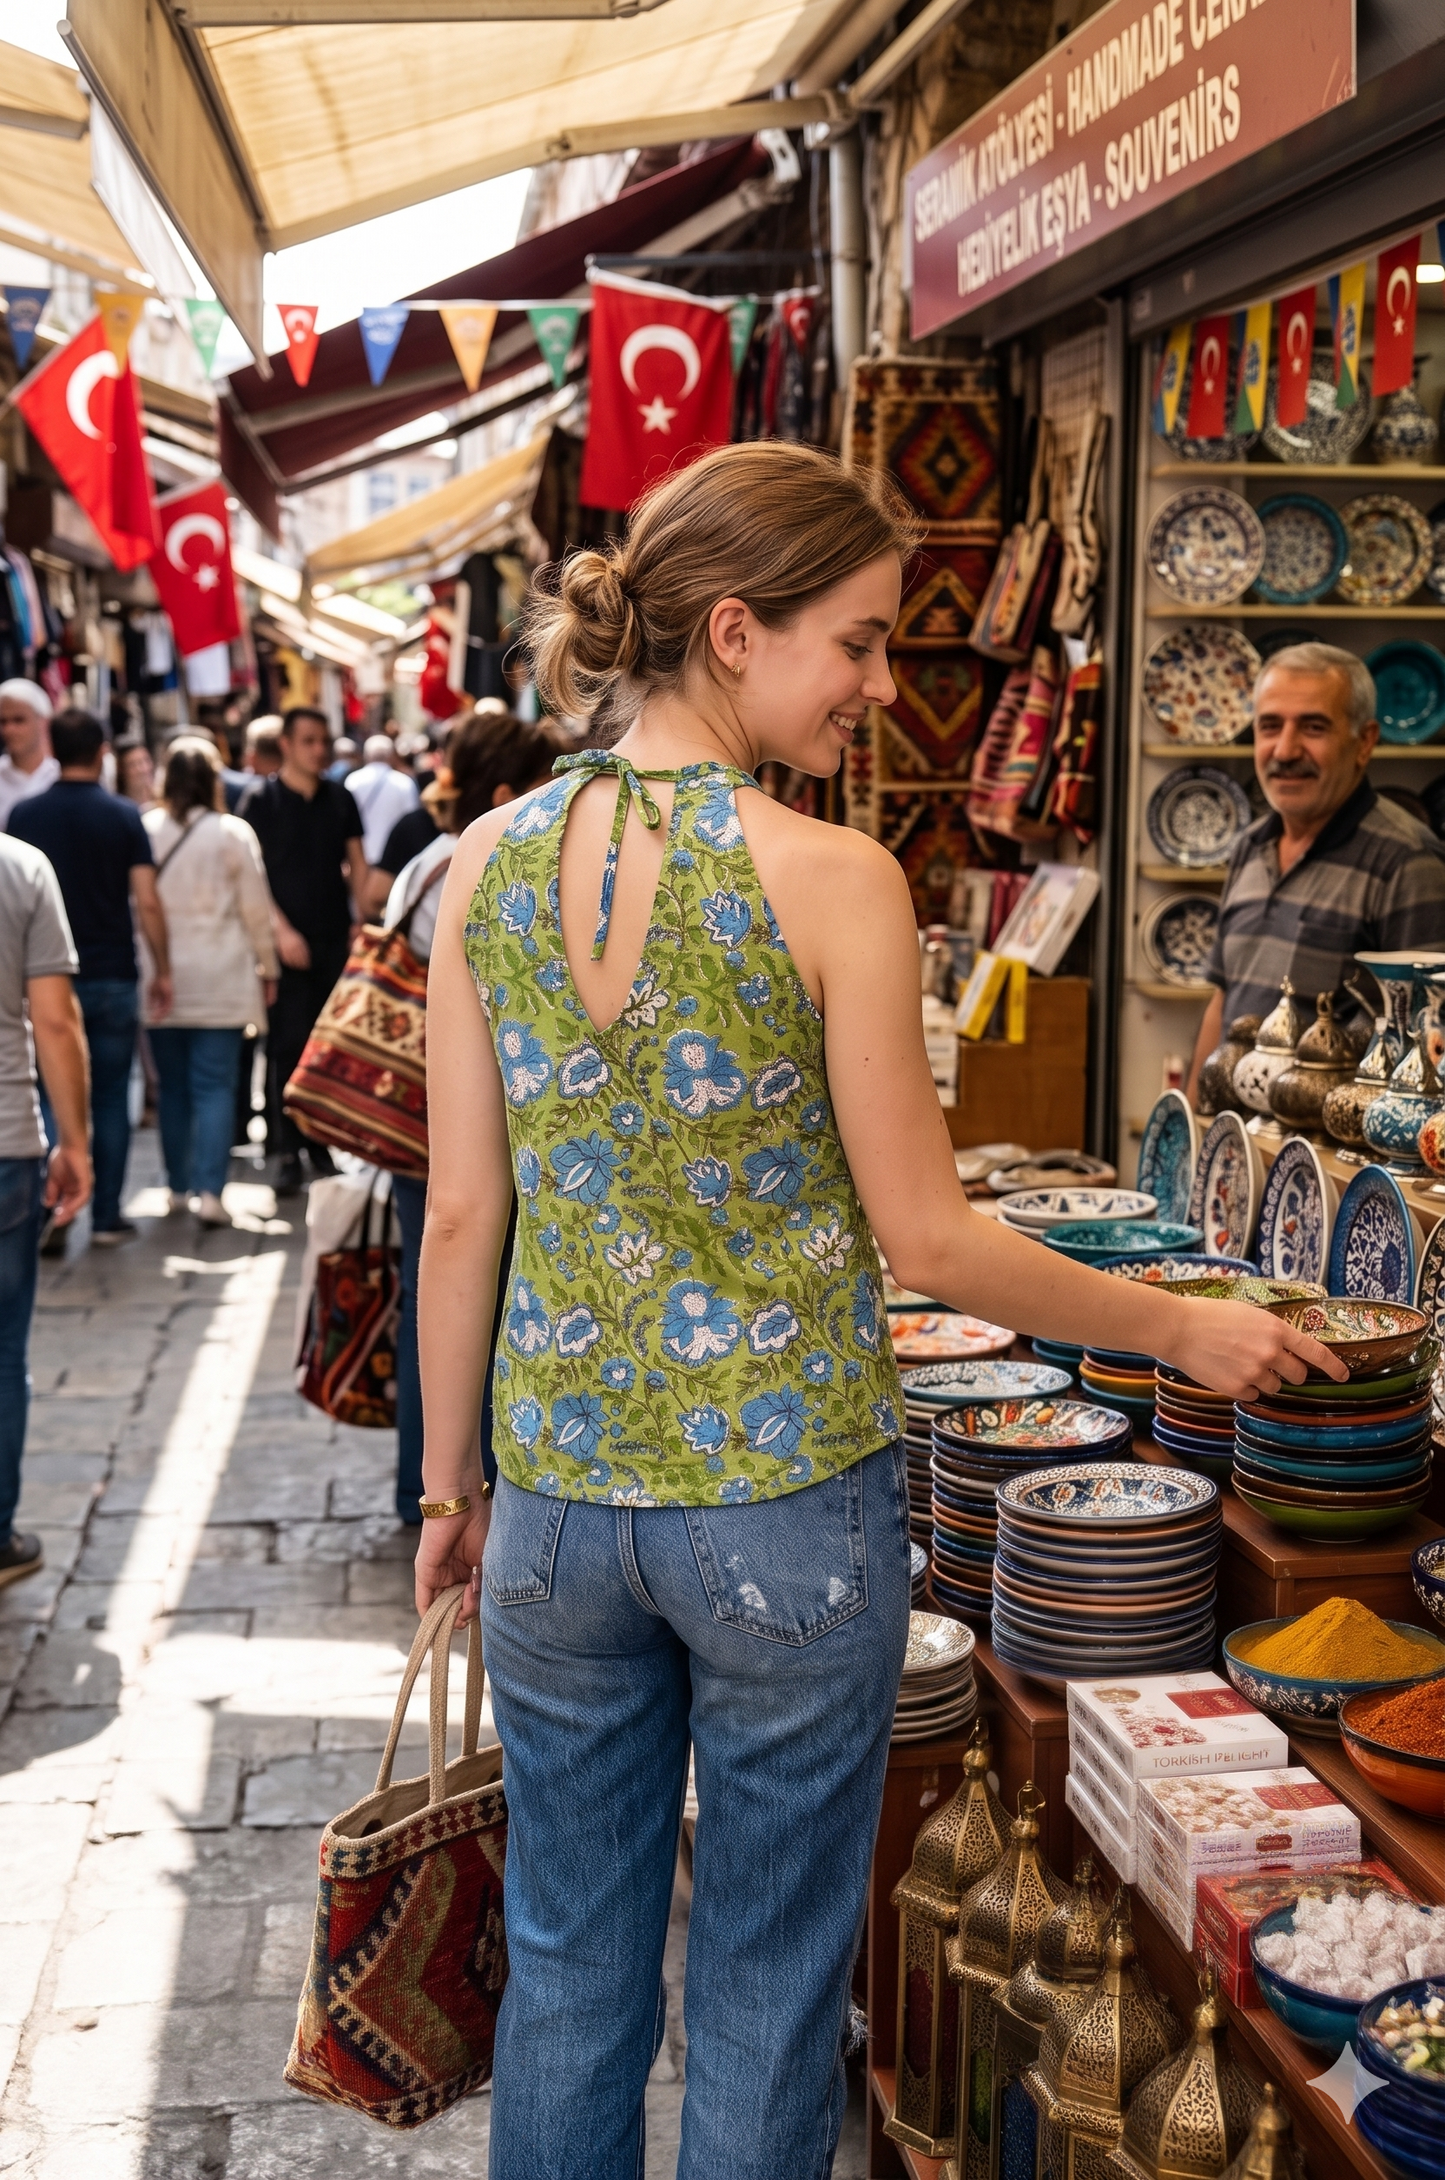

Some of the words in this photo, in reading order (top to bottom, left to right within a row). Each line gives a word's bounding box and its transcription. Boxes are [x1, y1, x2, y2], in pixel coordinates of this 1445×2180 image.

[914, 143, 977, 244] SERAMİK
[1067, 0, 1185, 138] HANDMADE
[956, 186, 1041, 298] HEDİYELİK
[1041, 160, 1092, 259] EŞYA
[1104, 63, 1241, 211] SOUVENİRS
